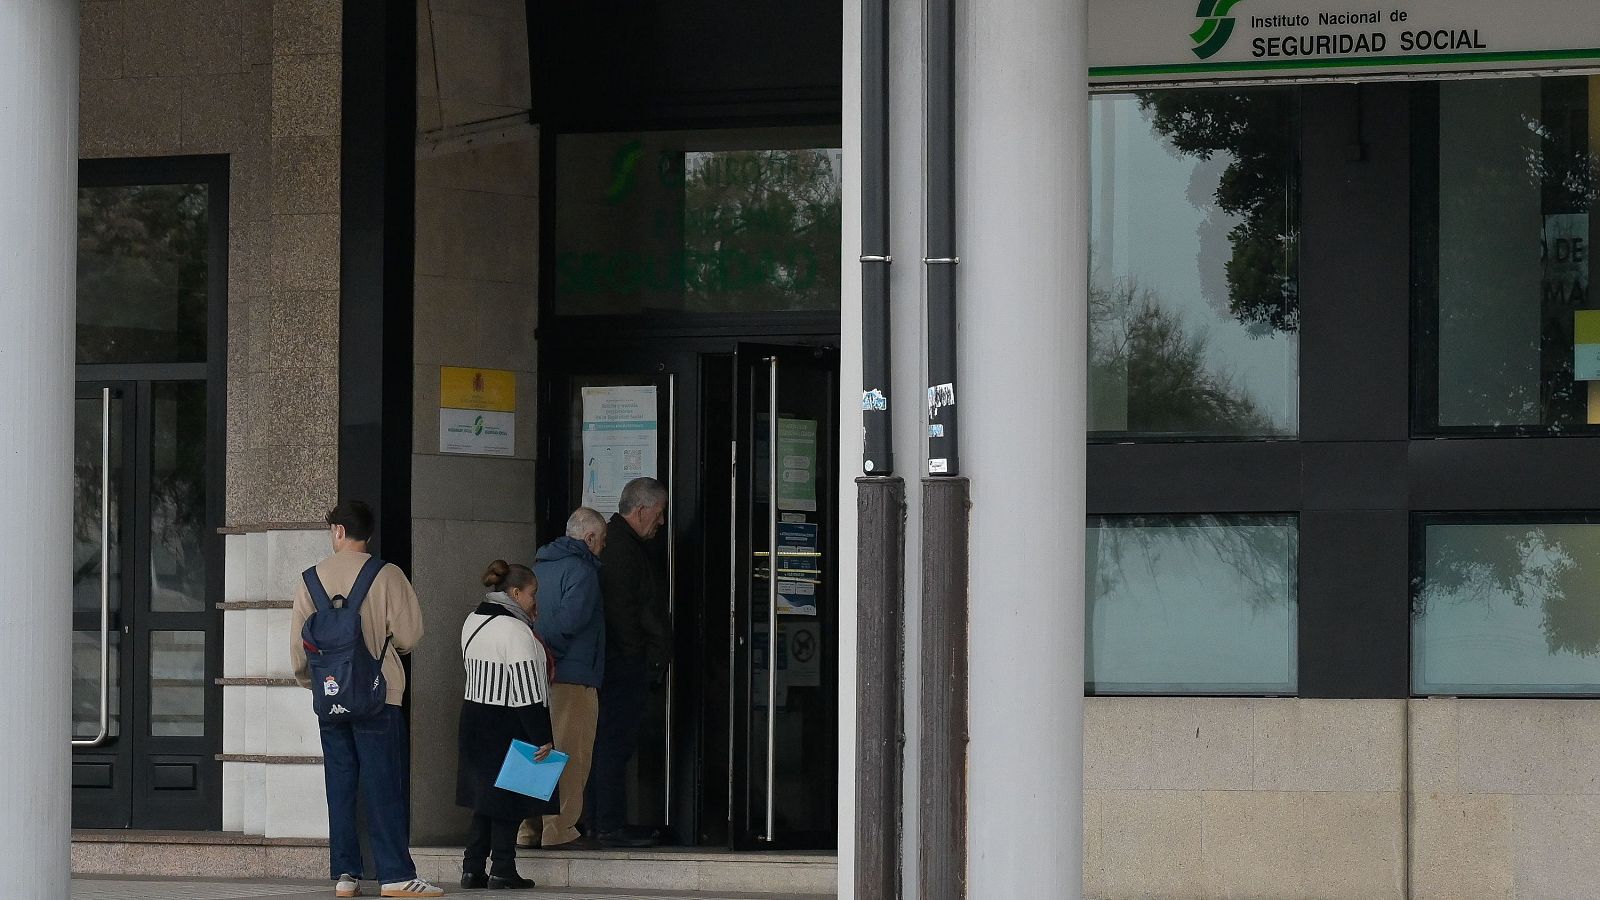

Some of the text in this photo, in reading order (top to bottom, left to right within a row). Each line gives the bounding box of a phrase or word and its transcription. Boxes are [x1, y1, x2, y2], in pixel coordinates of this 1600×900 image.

[1251, 9, 1408, 28] Instituto Nacional de
[1252, 29, 1487, 58] SEGURIDAD SOCIAL
